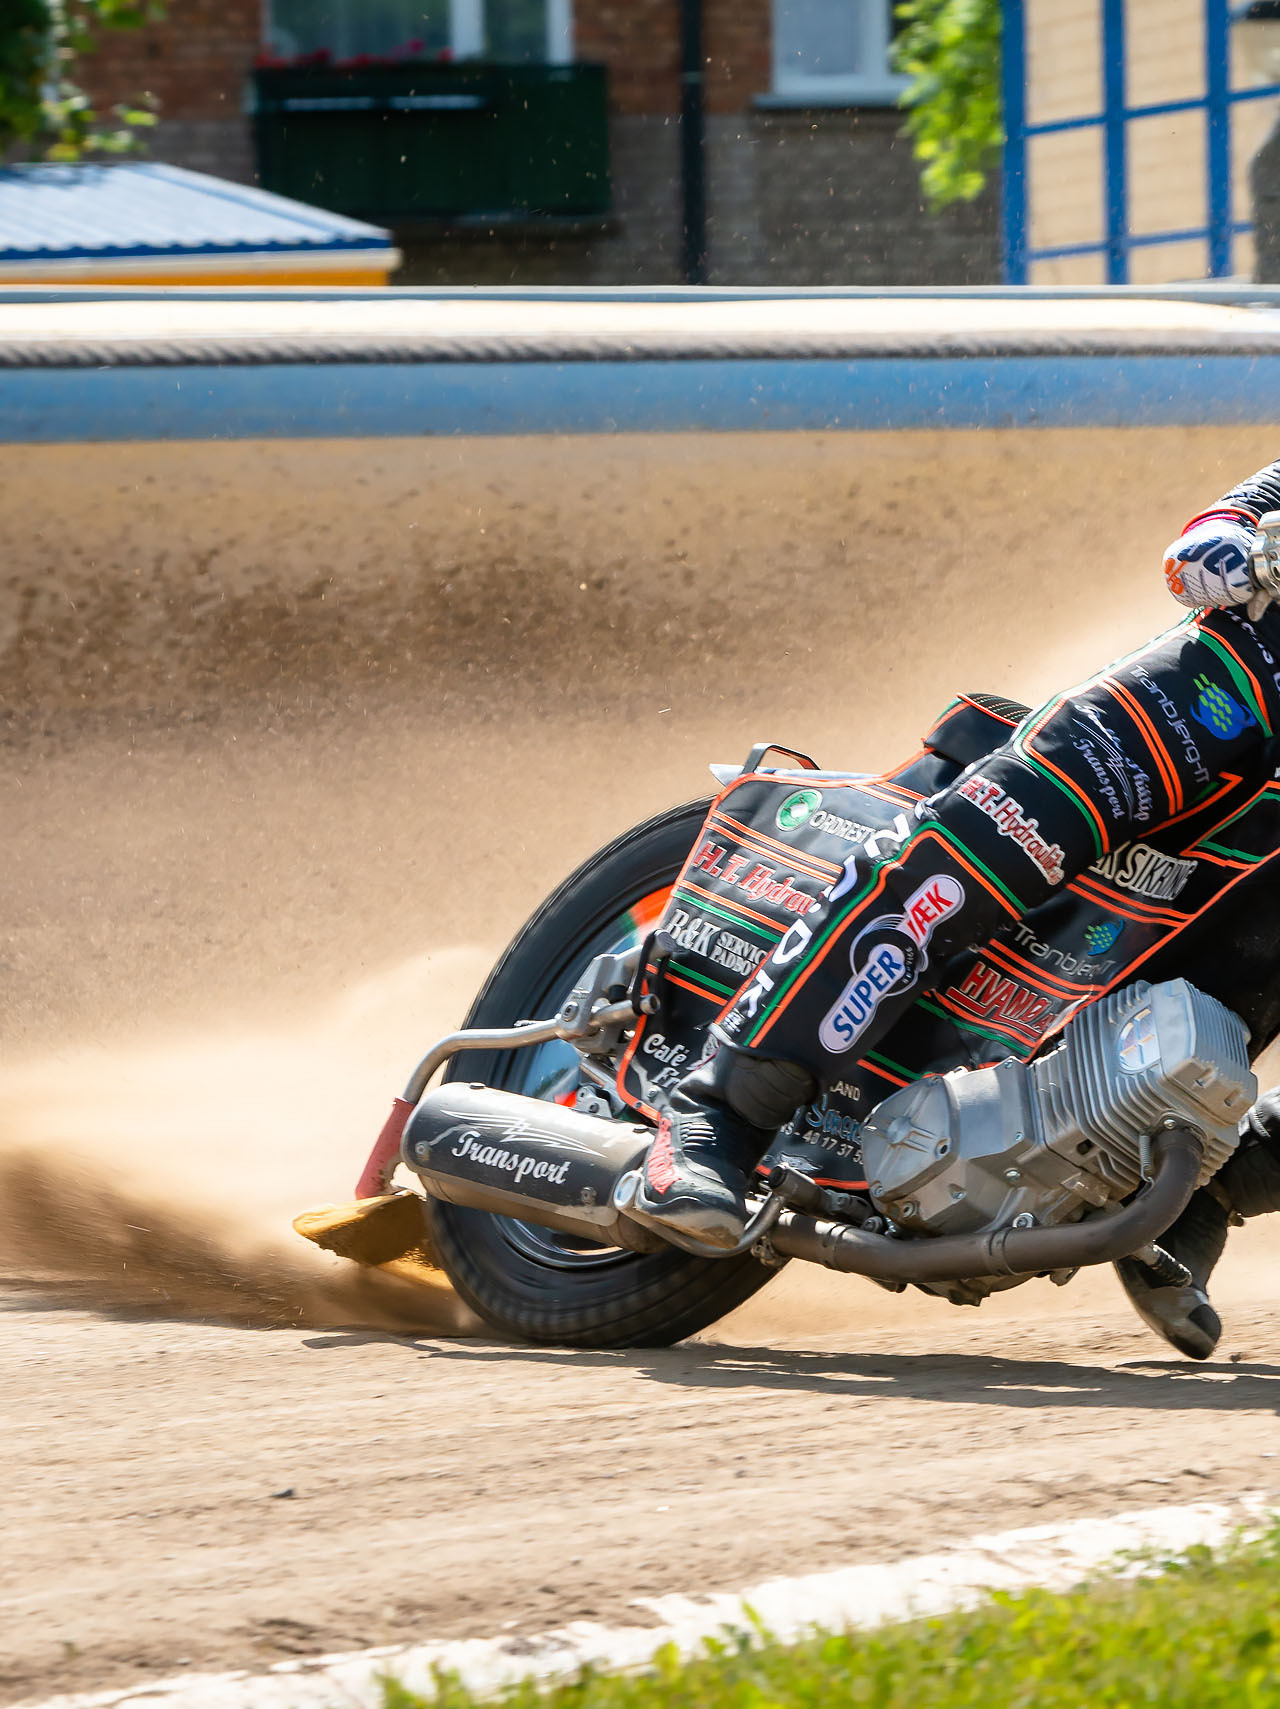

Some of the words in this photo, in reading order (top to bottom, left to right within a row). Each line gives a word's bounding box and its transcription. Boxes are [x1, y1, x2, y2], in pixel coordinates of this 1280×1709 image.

[716, 930, 768, 964] SERVIC
[833, 950, 902, 1043] SUPER
[642, 1033, 690, 1067] Café
[650, 1066, 681, 1088] Fr
[451, 1129, 571, 1185] Transport
[820, 1136, 839, 1151] 17
[836, 1143, 855, 1159] 37
